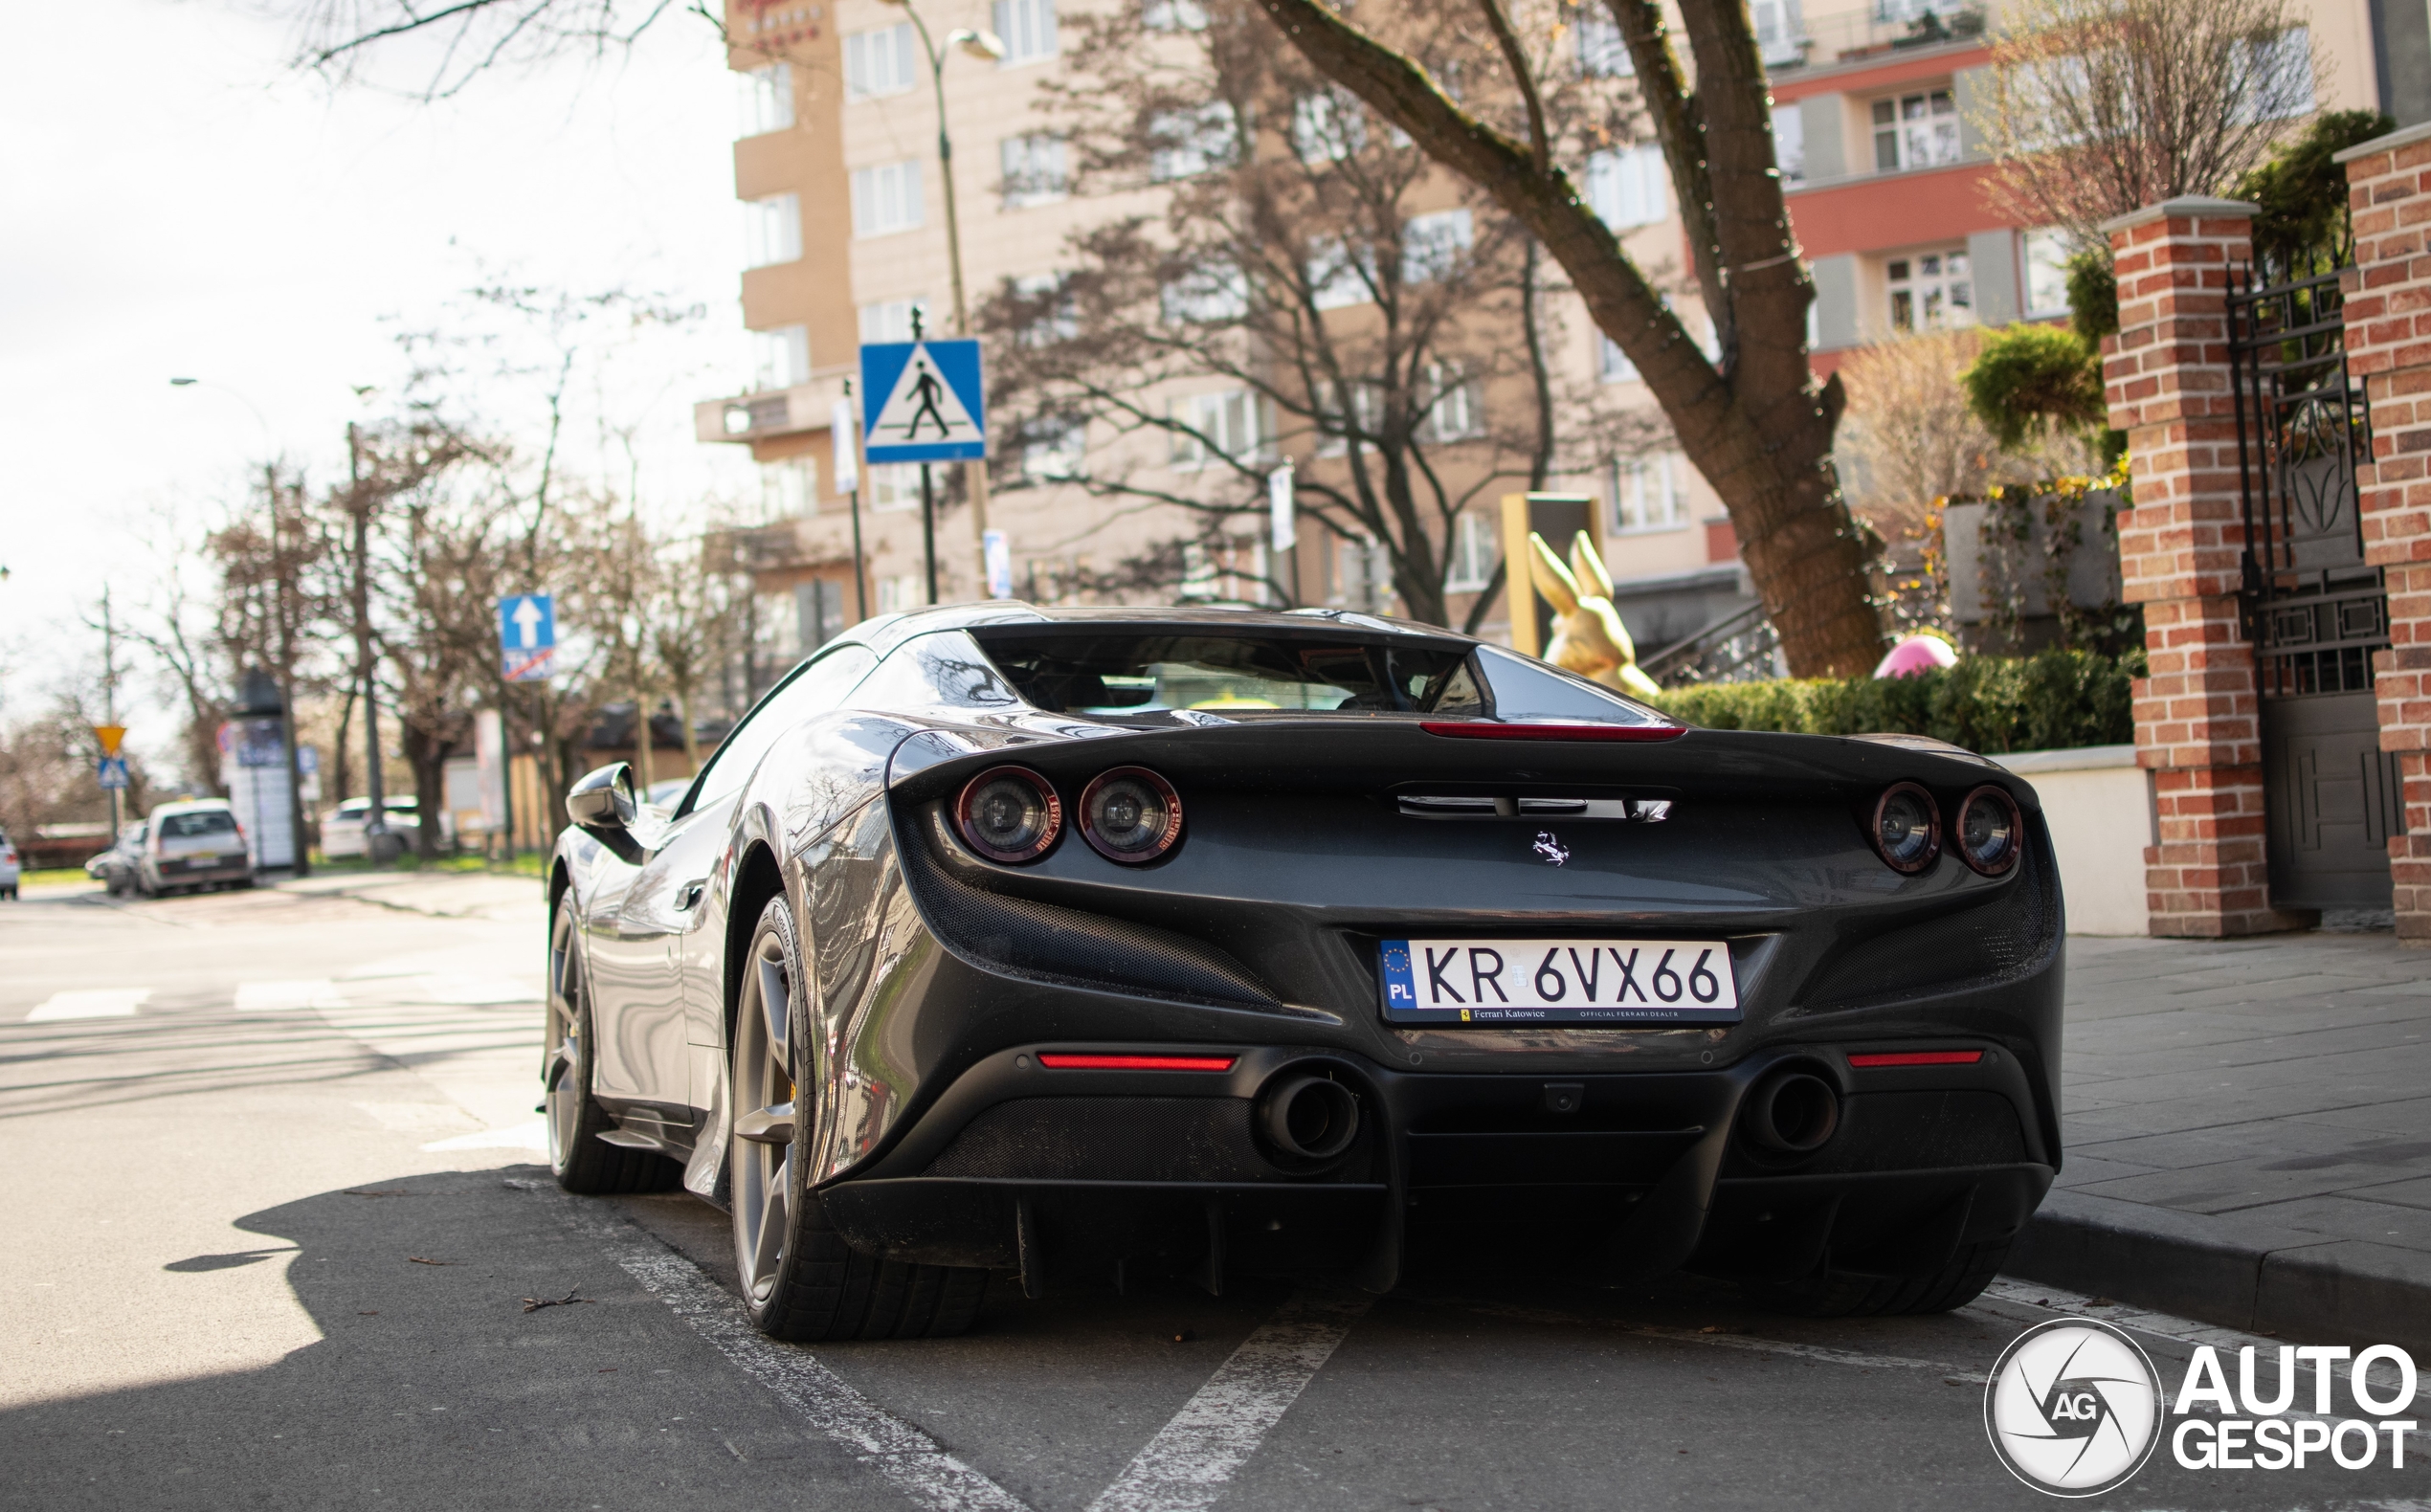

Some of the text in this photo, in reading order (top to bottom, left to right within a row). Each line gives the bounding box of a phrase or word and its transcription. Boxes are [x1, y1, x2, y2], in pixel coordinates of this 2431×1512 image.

[1424, 947, 1719, 1003] KR 6VX66
[1390, 984, 1412, 999] PL
[1474, 1009, 1545, 1018] Ferrari Katowice
